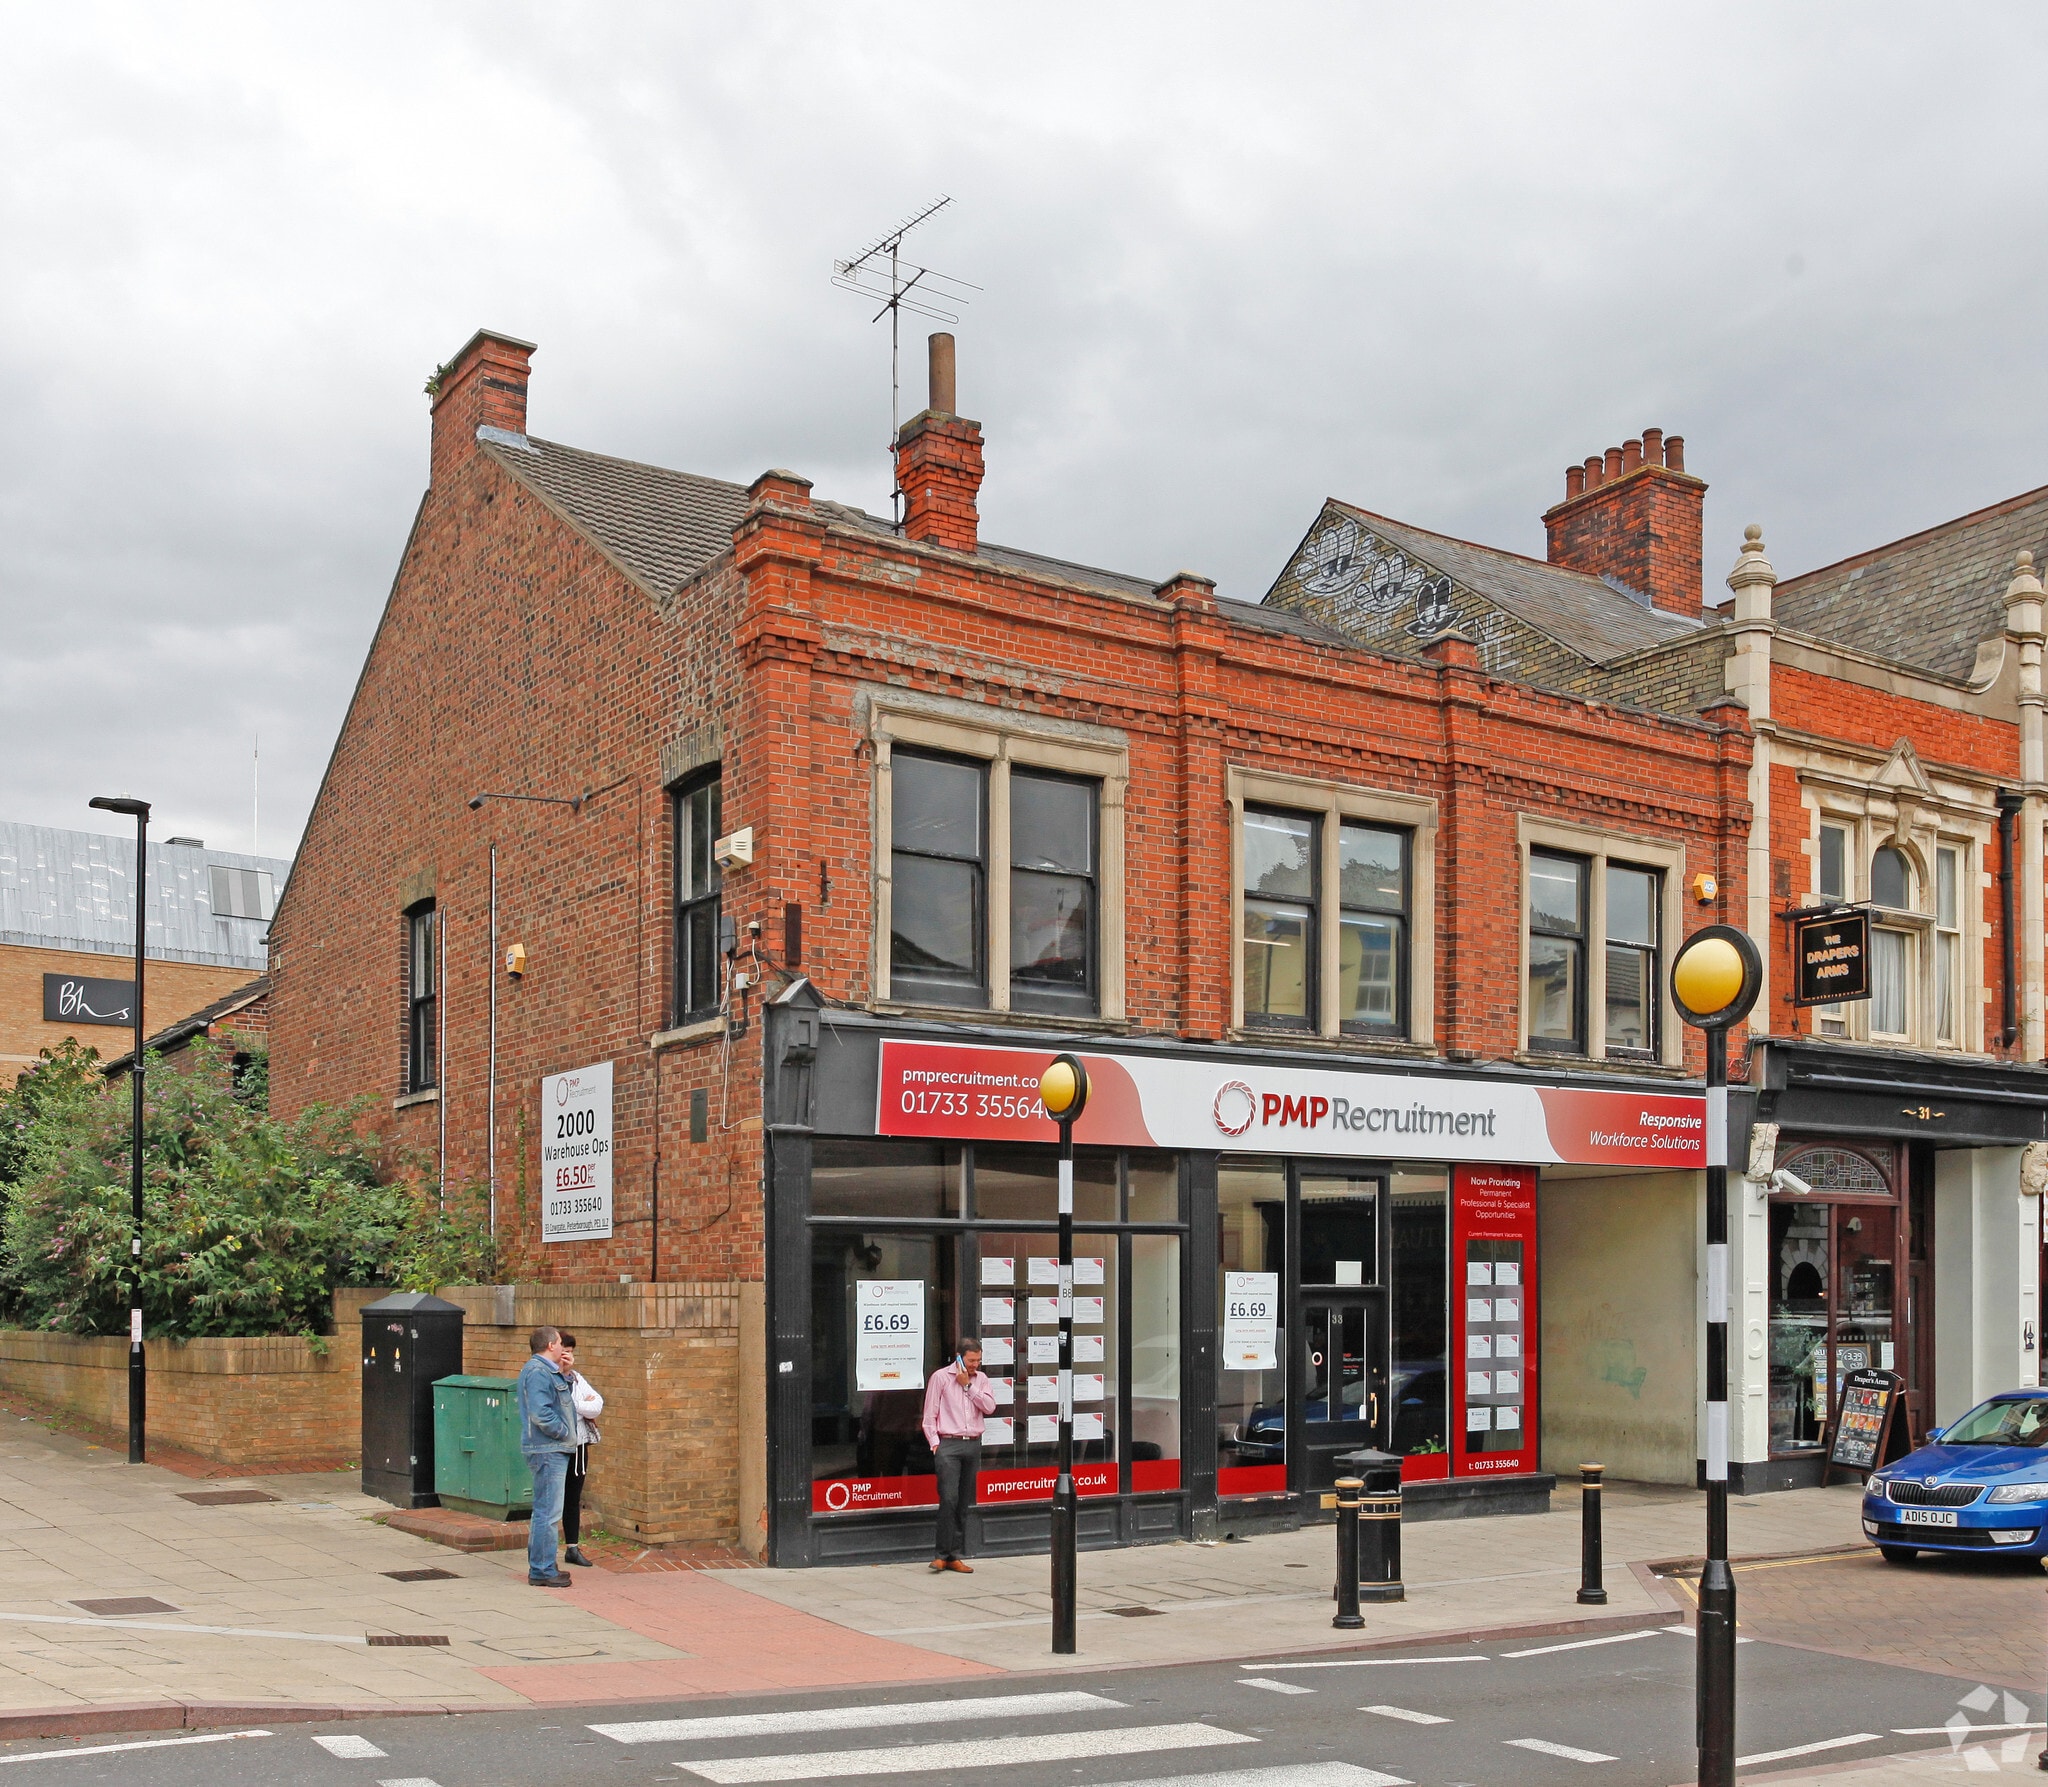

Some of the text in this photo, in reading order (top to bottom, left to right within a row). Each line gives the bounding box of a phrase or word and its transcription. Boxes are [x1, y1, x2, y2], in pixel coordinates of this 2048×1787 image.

[1824, 934, 1841, 945] THE
[1806, 945, 1859, 964] DRAPERS
[1816, 963, 1849, 979] ARMS
[902, 1070, 1041, 1089] pmprecruitment.co.
[901, 1090, 968, 1116] 01733
[1261, 1092, 1497, 1137] PMP Recruitment
[1639, 1111, 1702, 1130] Responsive
[1917, 1106, 1930, 1120] 31
[557, 1109, 595, 1139] 2000
[1590, 1130, 1701, 1151] Workforce Solutions
[545, 1138, 609, 1161] Warehouse Ops
[556, 1165, 588, 1187] £6.50
[1470, 1177, 1521, 1189] Now Providing
[1480, 1188, 1512, 1197] Permanent
[550, 1196, 603, 1216] 01733 355640
[1460, 1198, 1496, 1208] Professional
[1503, 1200, 1531, 1209] Specialist
[1475, 1210, 1516, 1219] Opportunities
[1230, 1302, 1266, 1317] £6.69
[863, 1314, 910, 1331] £6.69
[1331, 1314, 1343, 1324] 33
[1854, 1375, 1874, 1385] Draper's
[1474, 1461, 1494, 1470] 01733
[1495, 1459, 1519, 1468] 355640
[852, 1483, 872, 1493] PMP
[987, 1473, 1107, 1495] pmprecruitm.co.uk
[852, 1491, 902, 1502] Recruitment
[1905, 1511, 1953, 1524] AD15 OJC
